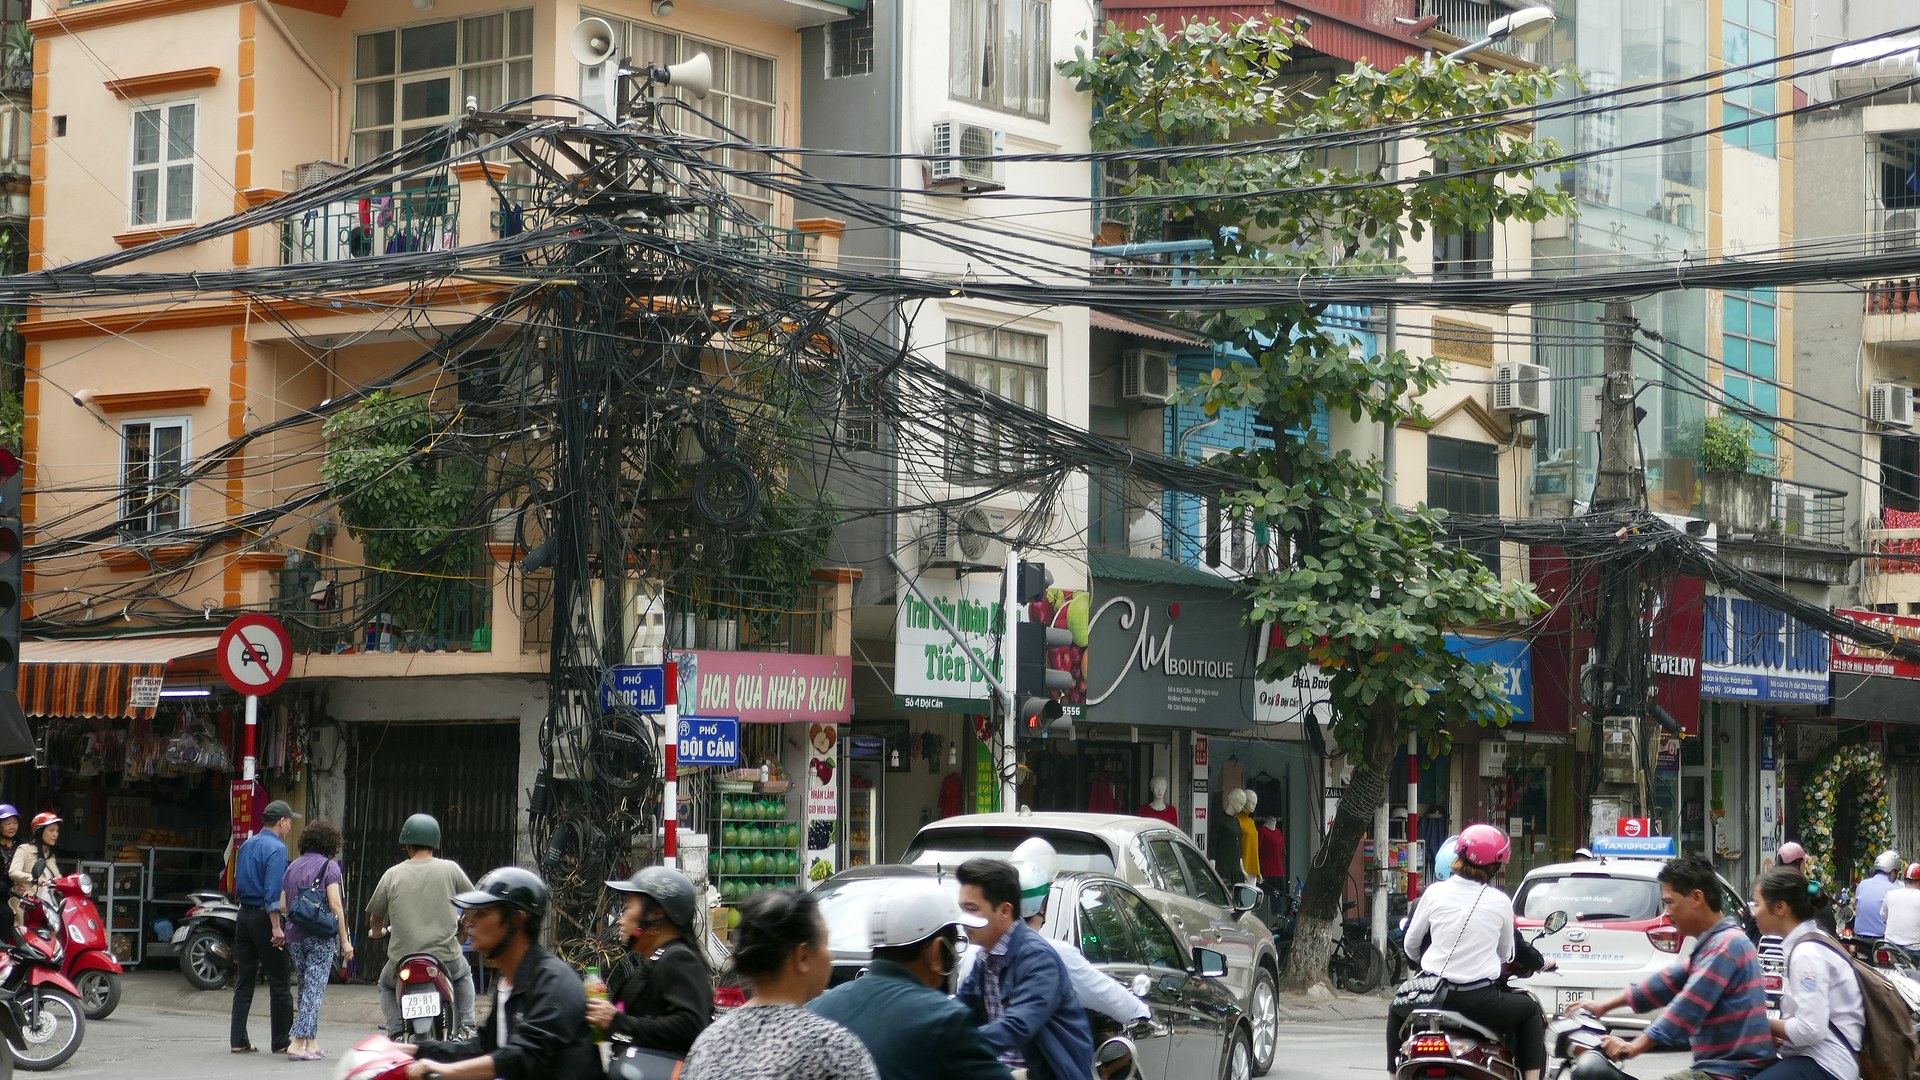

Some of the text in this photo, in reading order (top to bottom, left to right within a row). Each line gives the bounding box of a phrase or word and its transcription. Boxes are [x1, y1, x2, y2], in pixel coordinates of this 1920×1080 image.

[957, 598, 988, 639] Nhập
[925, 639, 1004, 691] Tiến Đạt
[1170, 658, 1233, 678] BOUTIQUE
[623, 671, 642, 685] PHỐ
[1292, 673, 1329, 689] Bán Buô
[640, 685, 656, 706] HÀ
[700, 662, 847, 719] HOA QUẢ NHẬP KHẨU
[905, 697, 943, 710] Số 4 Đội Cấn
[1275, 693, 1280, 707] 8
[699, 723, 717, 735] PHỐ
[680, 734, 735, 760] ĐỘI CẤN
[810, 789, 835, 801] NHẬN LÀM
[1325, 788, 1342, 797] ZARA
[817, 805, 826, 815] HOA
[1562, 944, 1591, 953] ECO
[405, 1005, 437, 1017] 753.80
